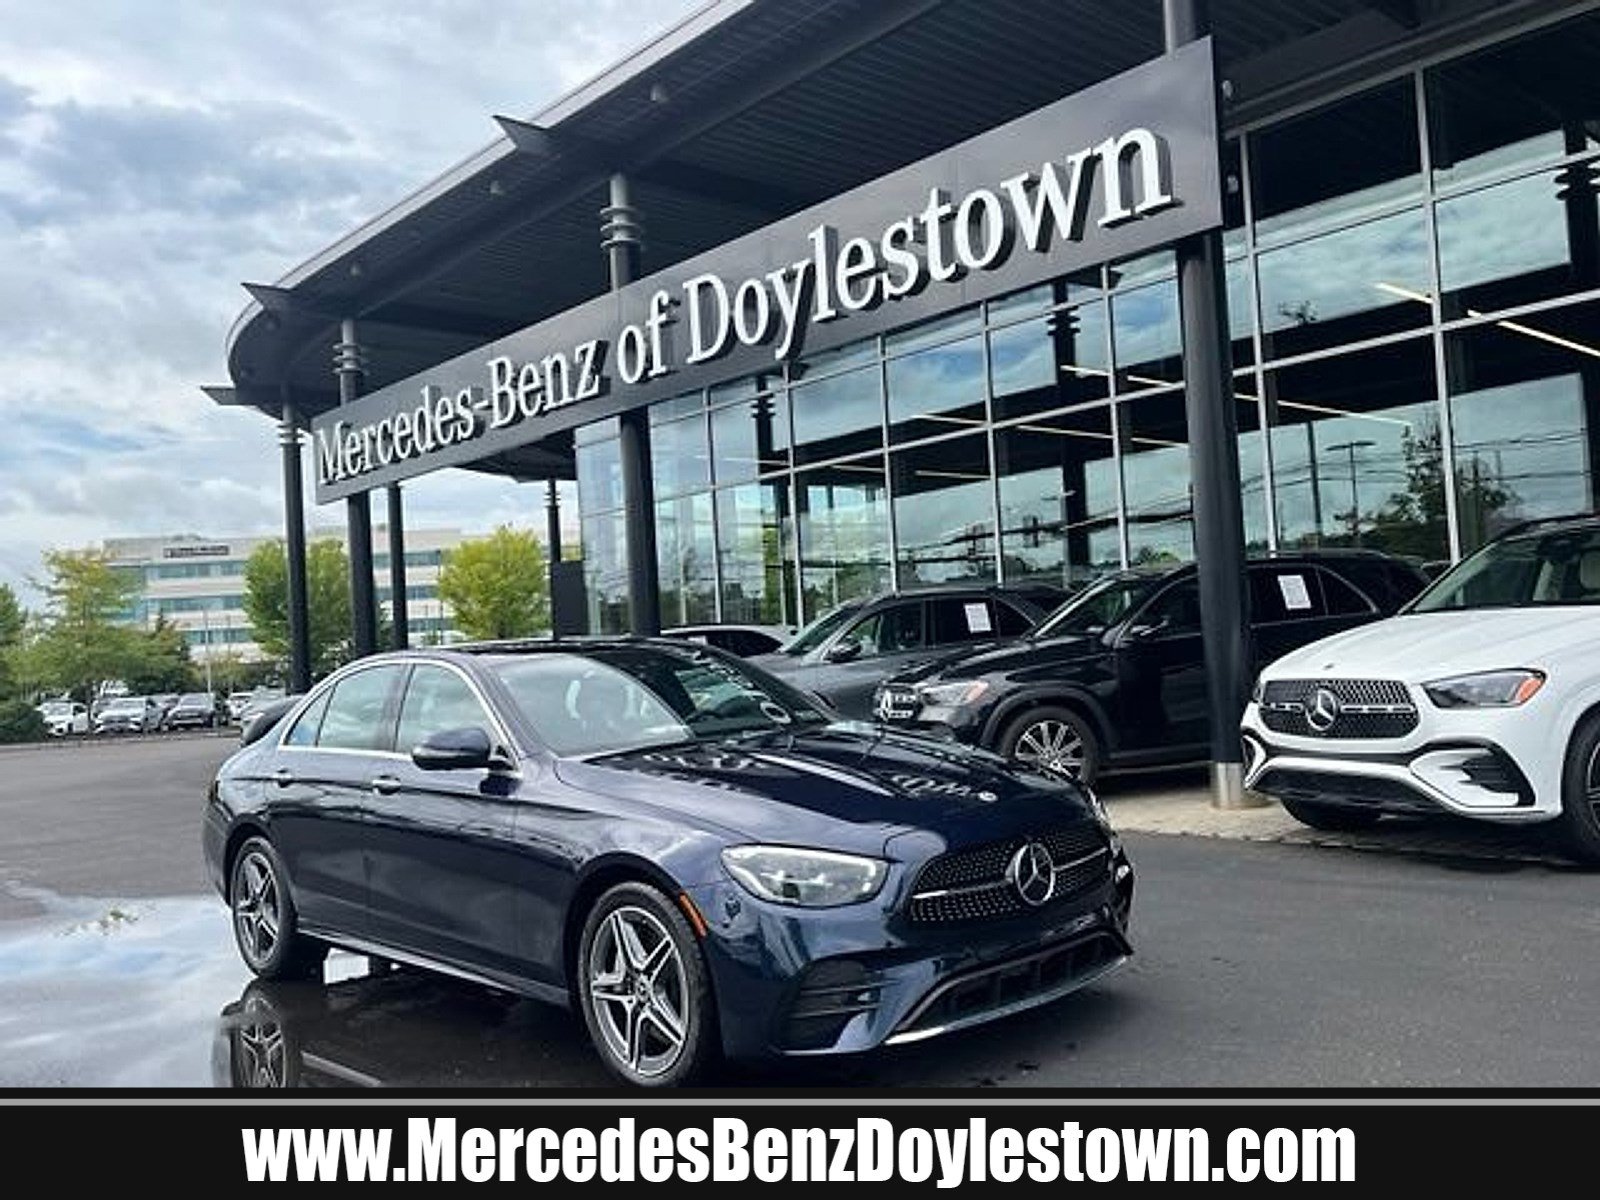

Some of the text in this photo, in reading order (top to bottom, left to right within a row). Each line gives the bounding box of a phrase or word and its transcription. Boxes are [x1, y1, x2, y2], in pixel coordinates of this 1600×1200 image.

[315, 127, 1174, 487] Mercedes-Benz of Doylestown
